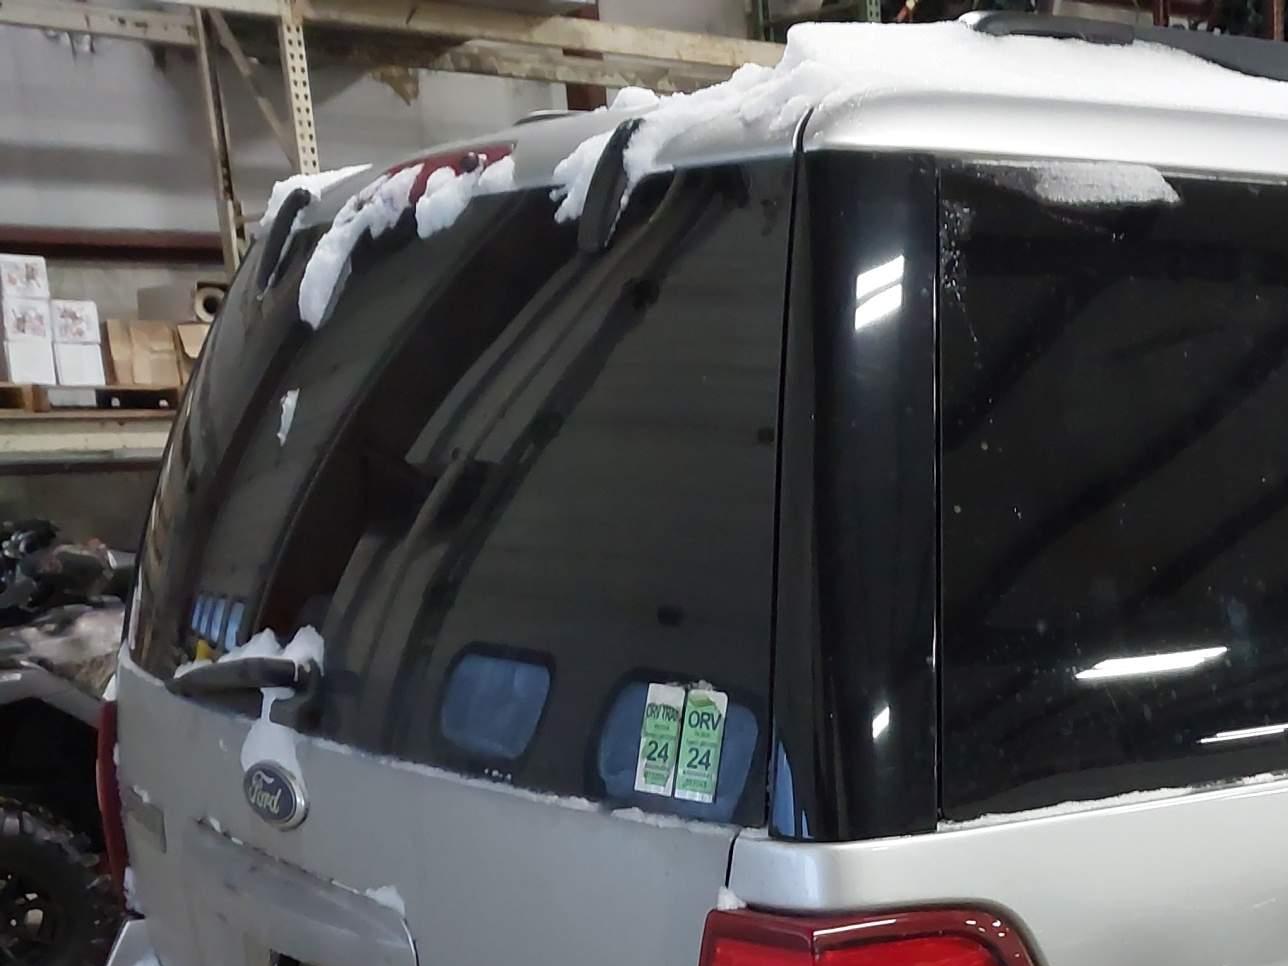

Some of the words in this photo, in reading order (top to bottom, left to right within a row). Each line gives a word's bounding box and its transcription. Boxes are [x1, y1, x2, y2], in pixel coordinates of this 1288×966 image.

[688, 710, 721, 731] ORV
[646, 740, 669, 763] 24
[686, 747, 711, 770] 24
[249, 770, 282, 814] Ford
